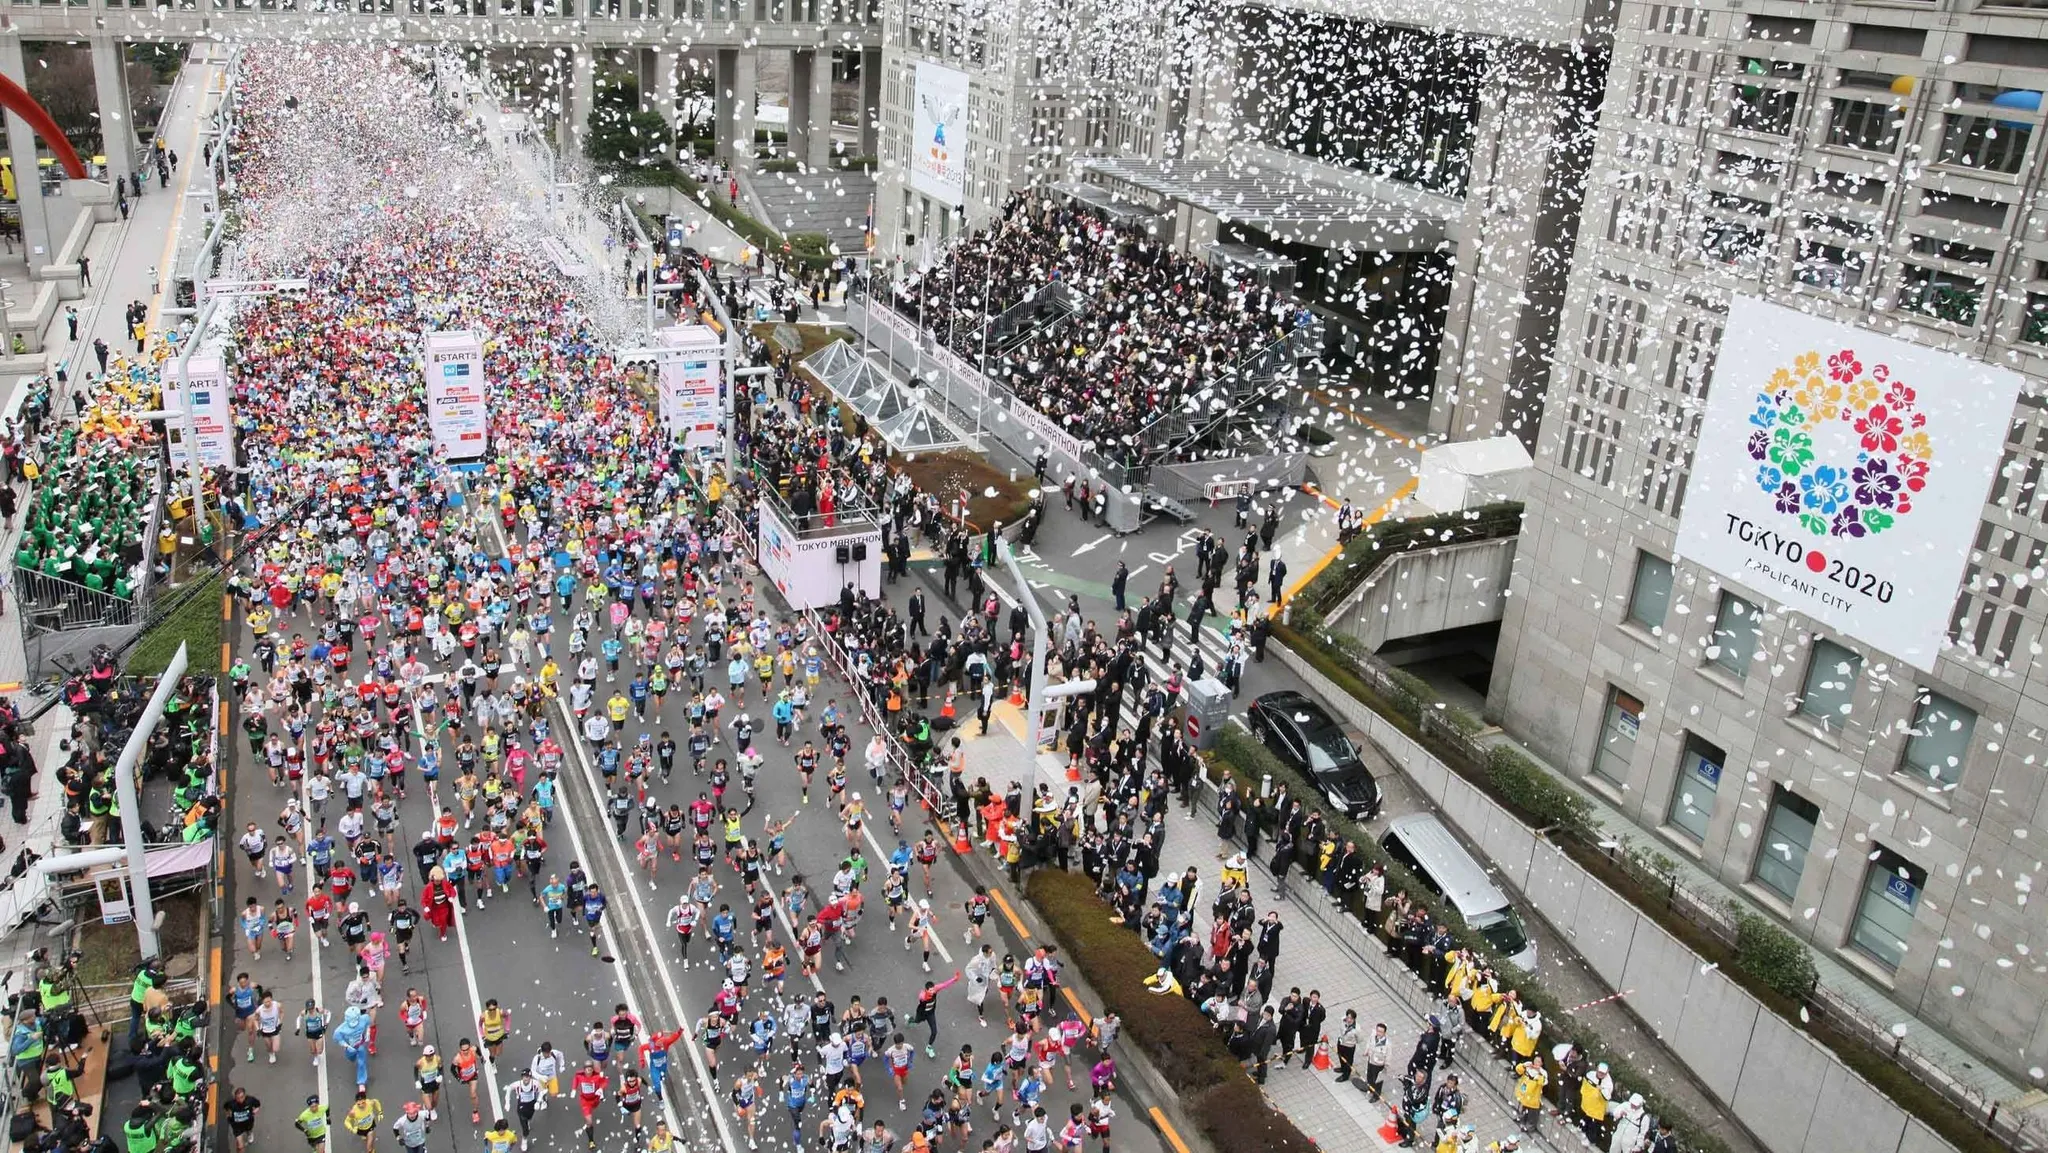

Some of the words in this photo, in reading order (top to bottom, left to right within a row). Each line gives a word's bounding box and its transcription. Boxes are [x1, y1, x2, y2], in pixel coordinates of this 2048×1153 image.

[440, 353, 471, 361] START
[176, 380, 211, 389] SART
[957, 362, 987, 392] ARATHON
[1013, 401, 1036, 427] TOKYO
[1036, 419, 1079, 456] MARATHON
[797, 540, 828, 552] TOKYO
[829, 533, 881, 547] MARATHON
[1726, 513, 1803, 563] TOKYO
[1828, 559, 1894, 604] 2020
[1821, 592, 1853, 613] CITY
